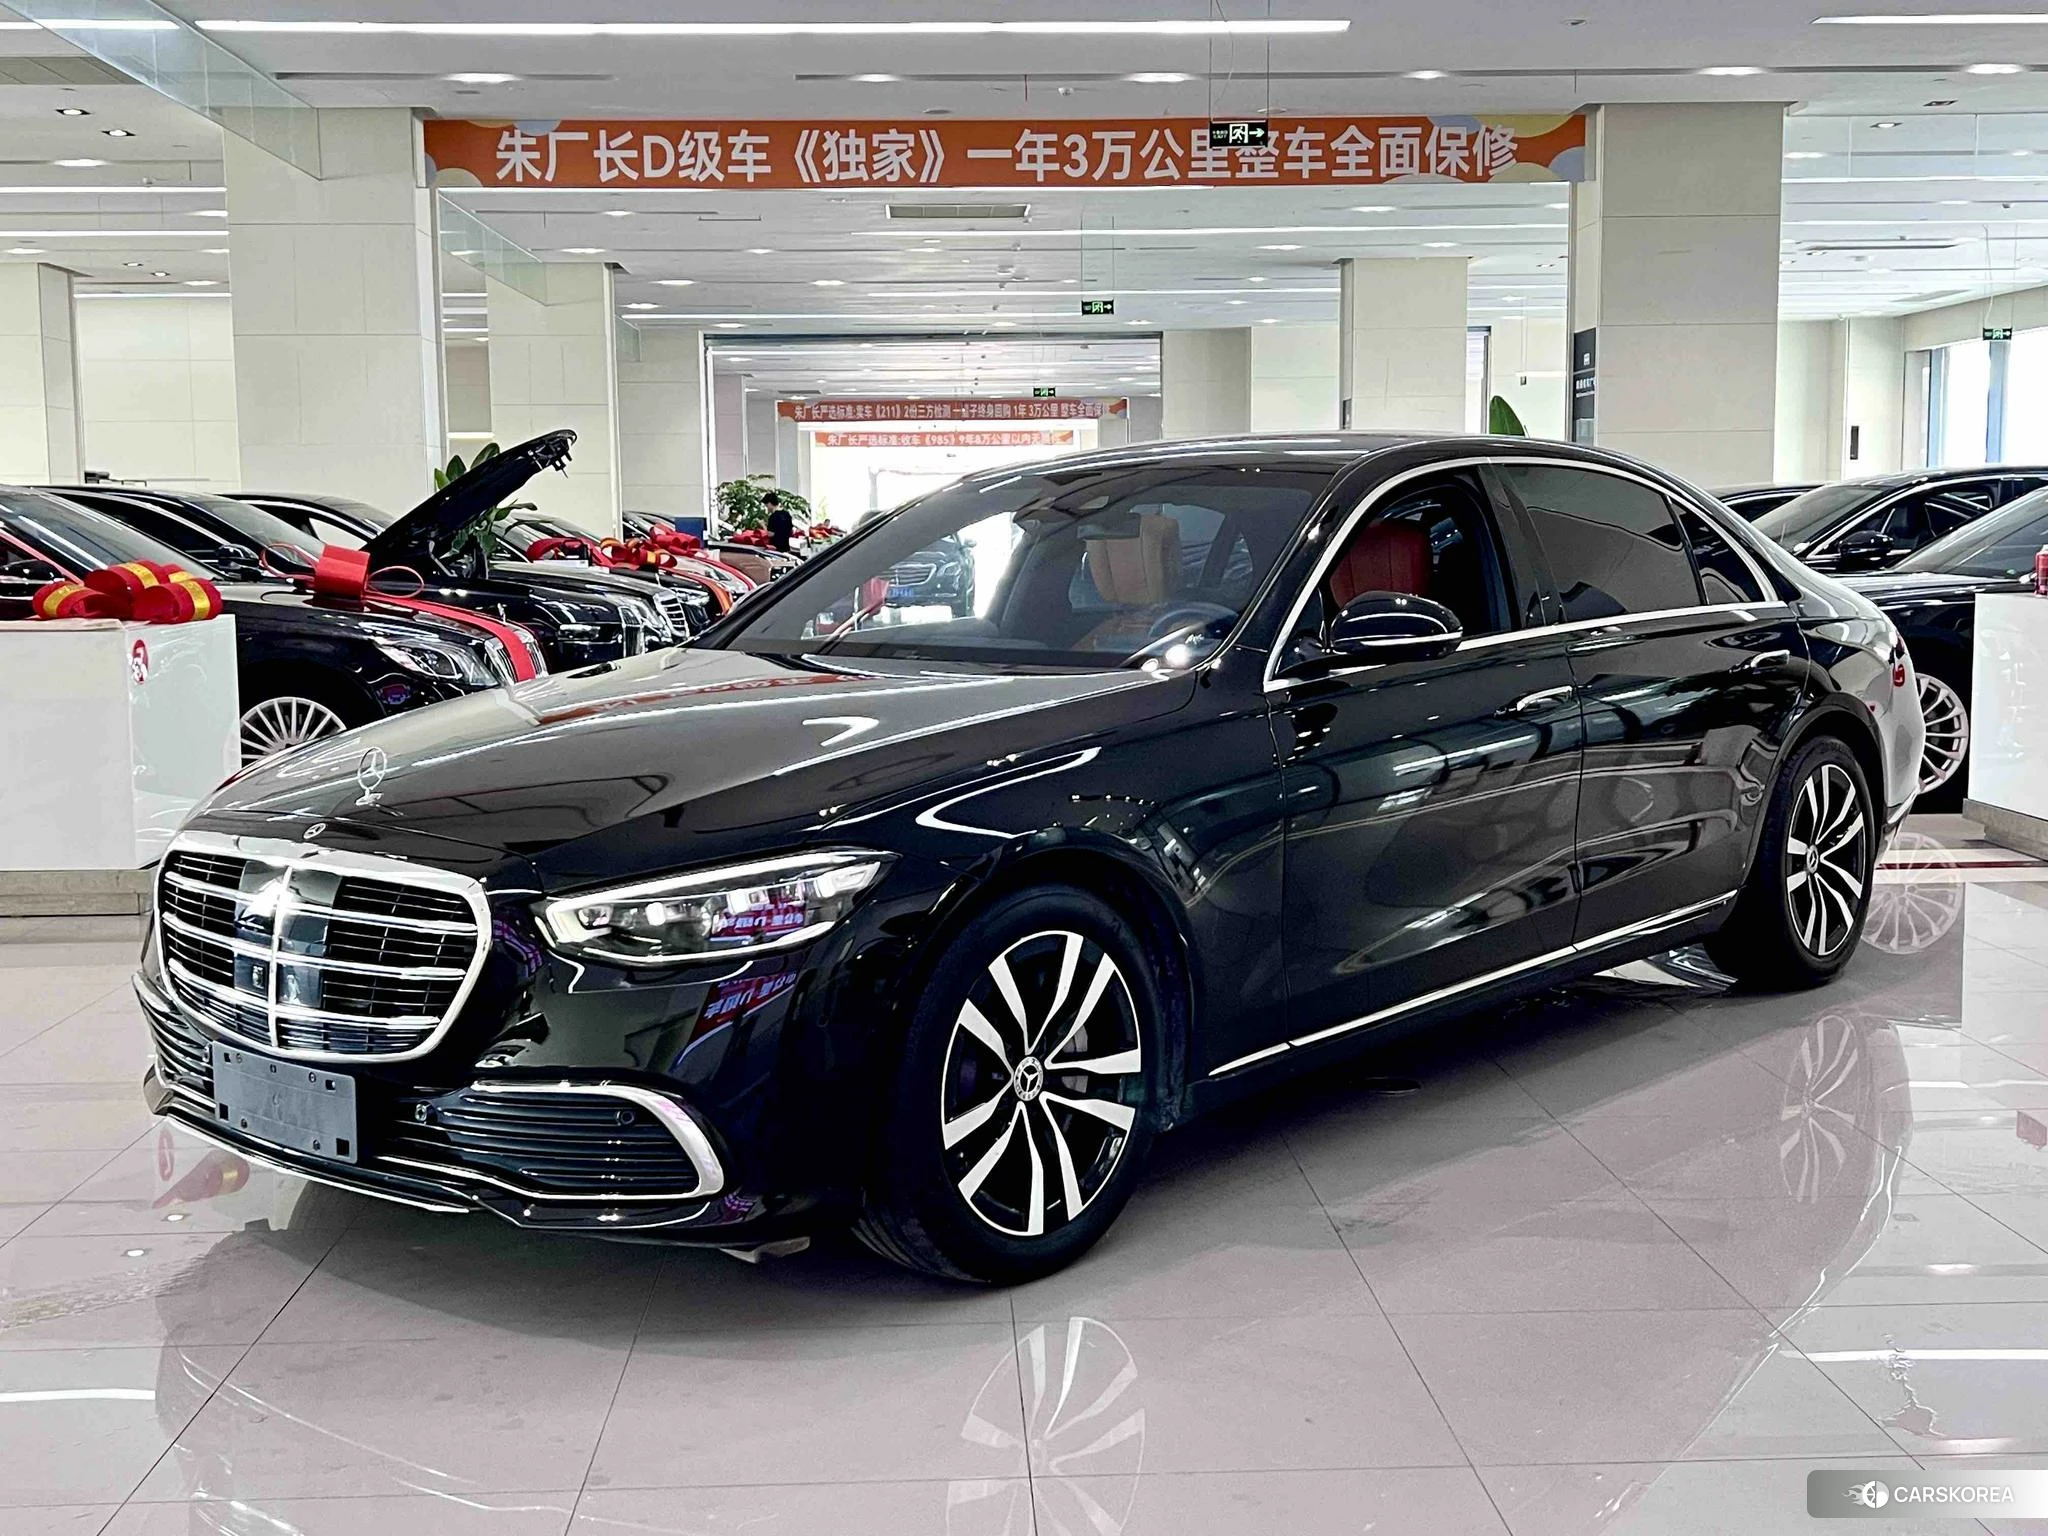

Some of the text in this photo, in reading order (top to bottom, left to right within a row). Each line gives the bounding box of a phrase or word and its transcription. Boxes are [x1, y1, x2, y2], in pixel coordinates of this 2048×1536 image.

[496, 125, 1518, 183] 朱厂长D级车《独家》一年3万公里整车全面保修
